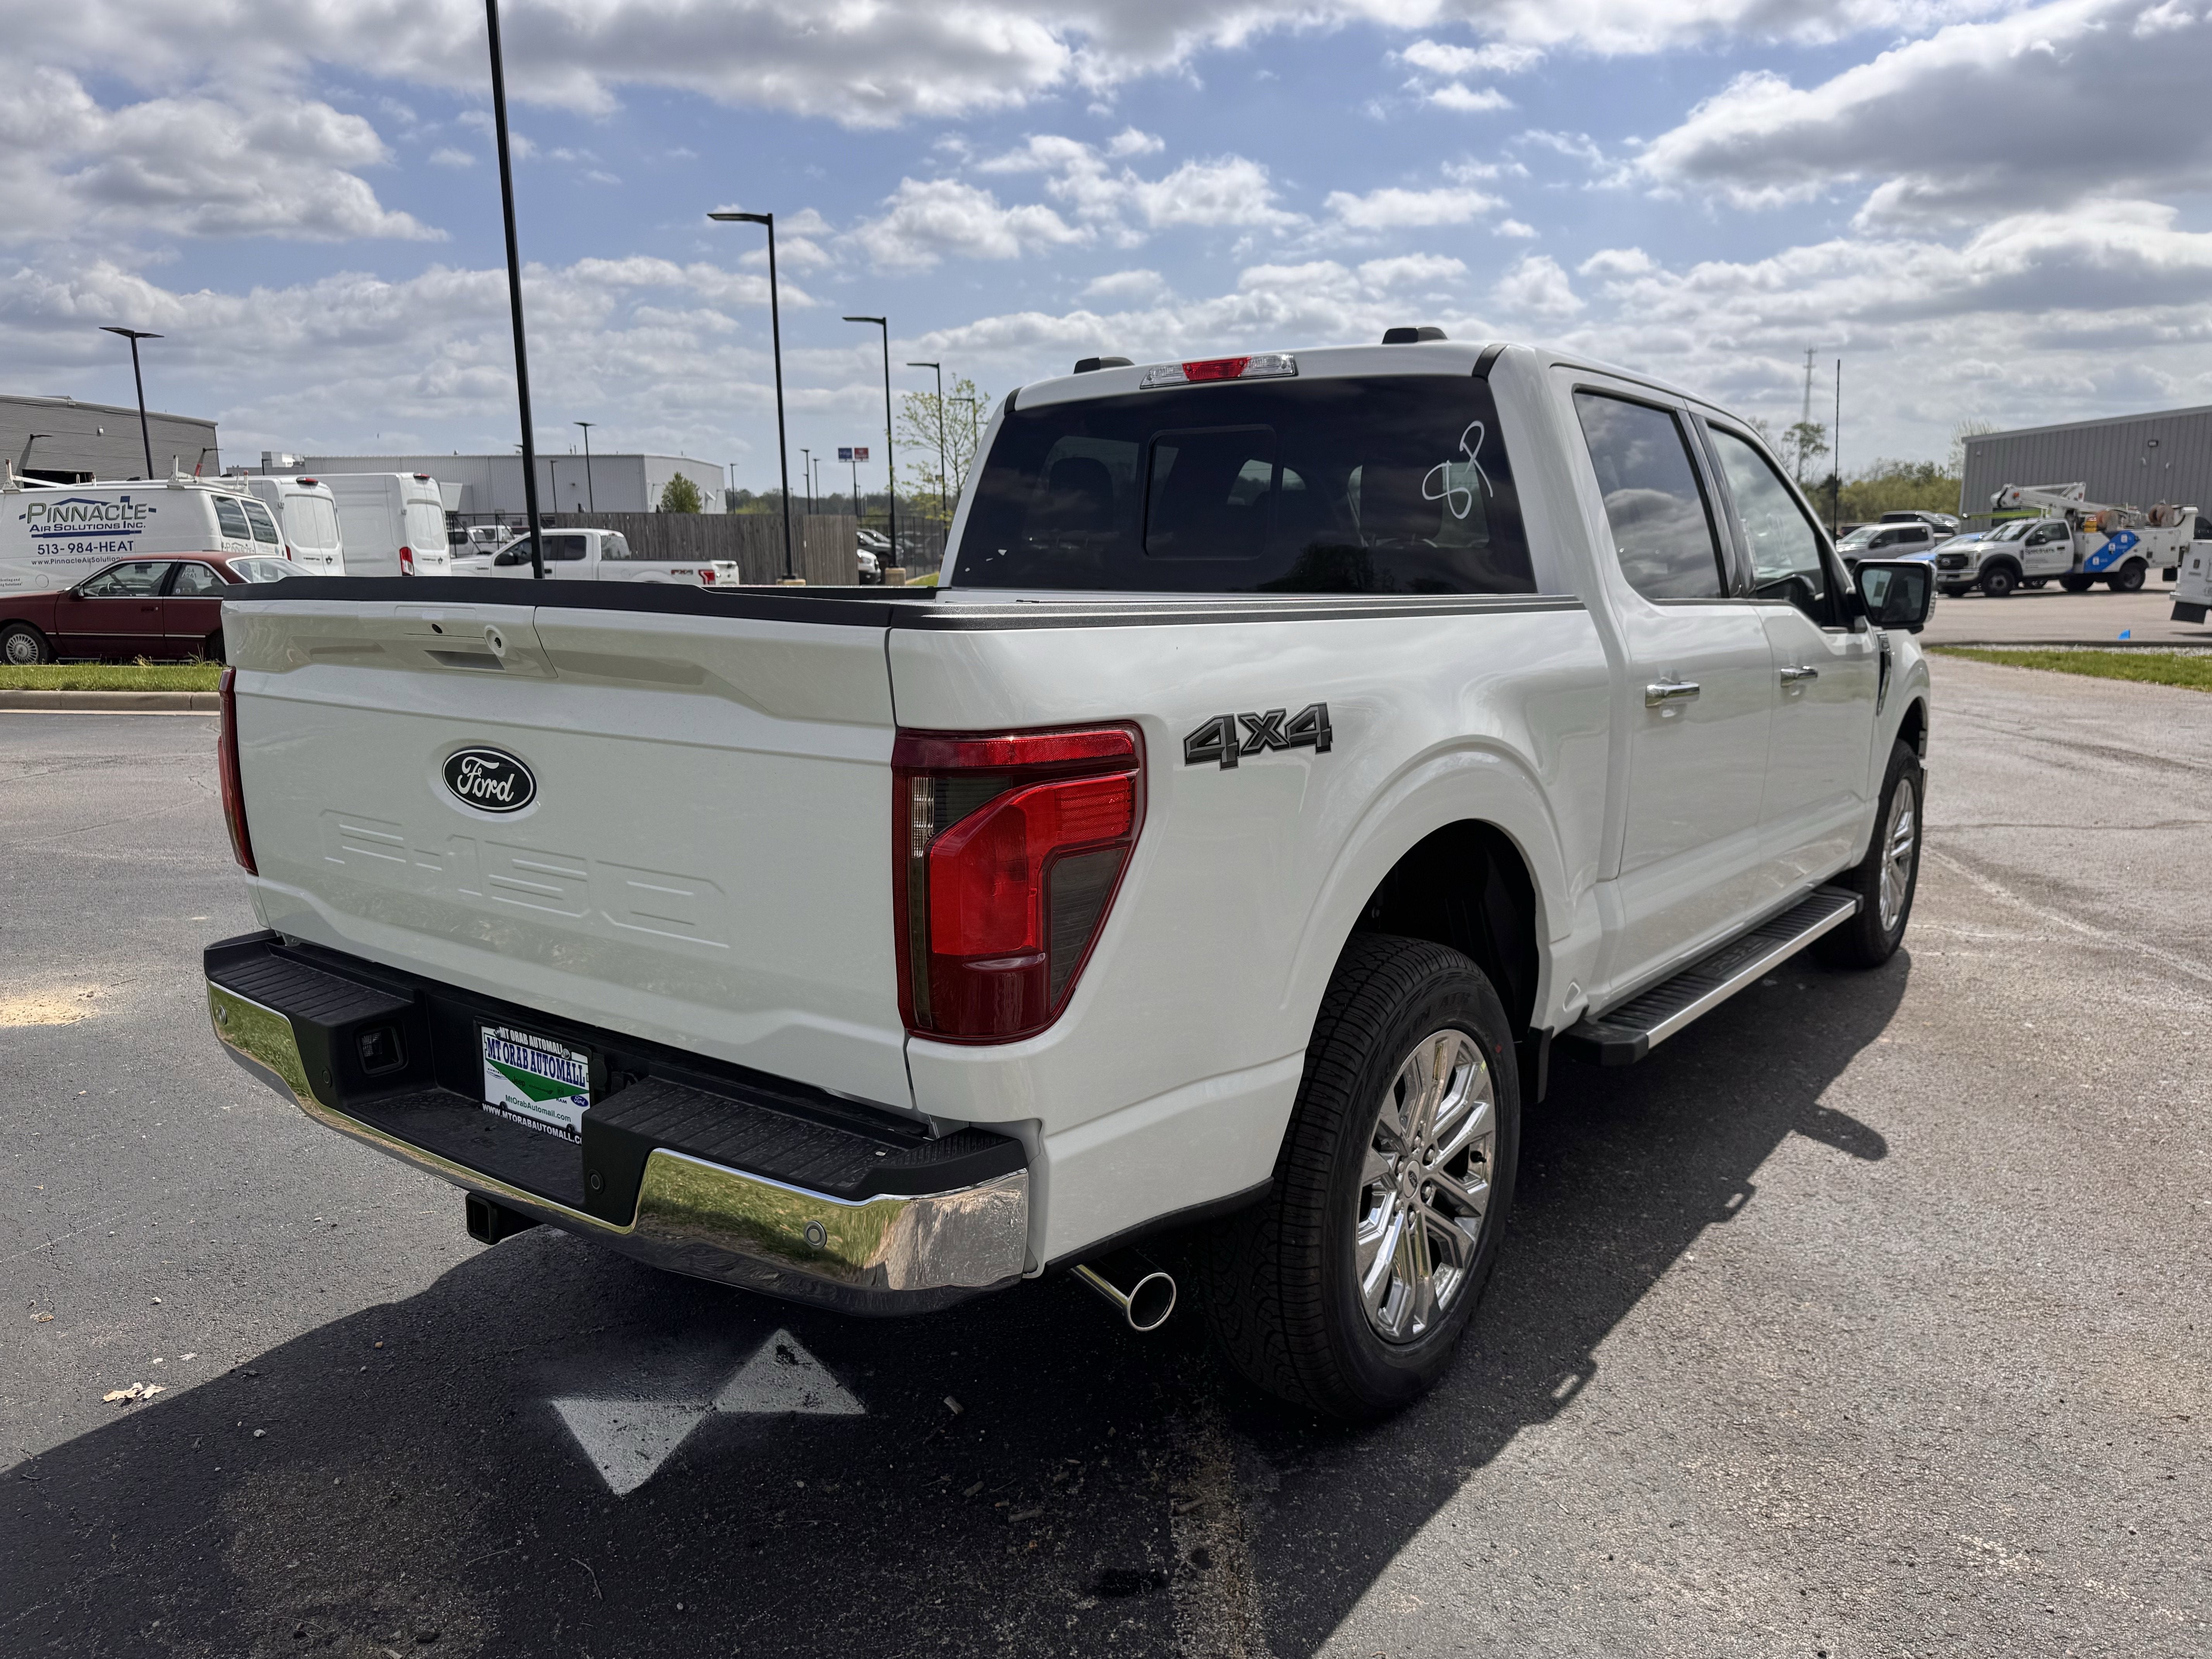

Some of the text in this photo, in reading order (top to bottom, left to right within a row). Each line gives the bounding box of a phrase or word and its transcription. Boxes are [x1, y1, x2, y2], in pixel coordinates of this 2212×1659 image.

[27, 503, 147, 524] PINNACLE
[32, 556, 123, 565] www.PinnacleAirSolution
[457, 756, 515, 802] Ford
[510, 1030, 528, 1045] ORAB
[487, 1037, 586, 1087] MT ORAB AUTOMALL
[512, 1075, 526, 1087] Jeep
[505, 1094, 571, 1122] MtOrabAutomall.com
